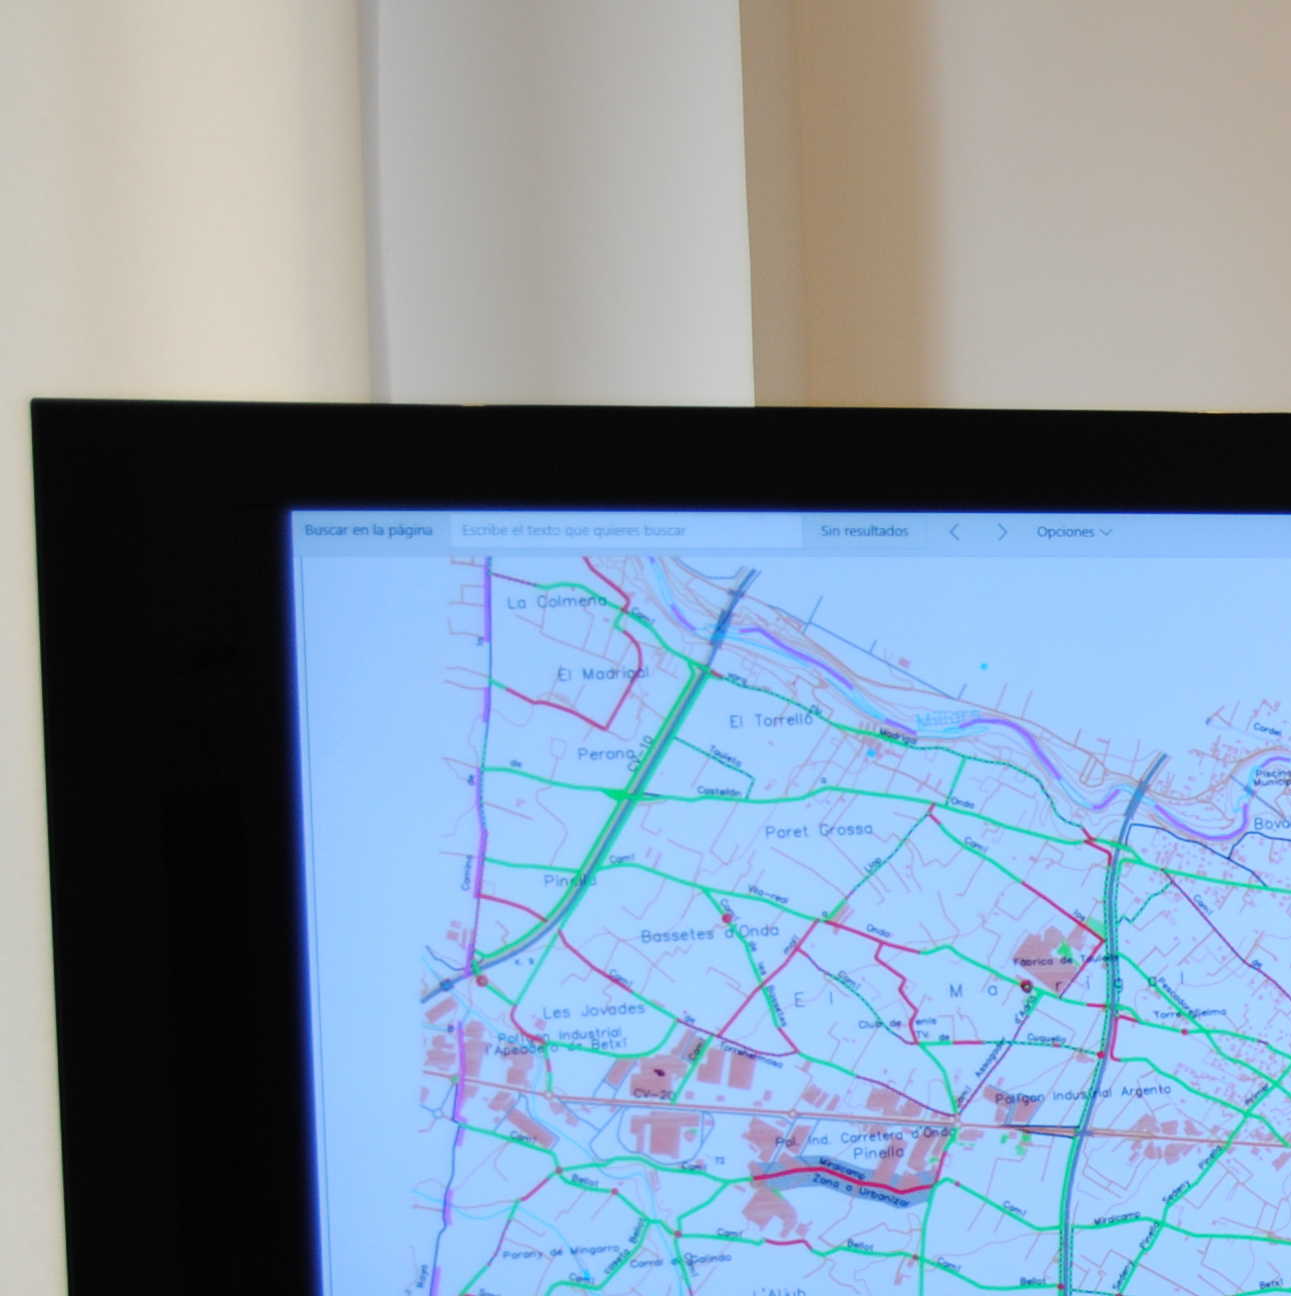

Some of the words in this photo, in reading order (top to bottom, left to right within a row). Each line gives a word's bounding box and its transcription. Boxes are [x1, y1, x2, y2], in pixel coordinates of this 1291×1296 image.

[304, 523, 348, 536] Buscar
[352, 526, 369, 536] en
[372, 523, 385, 536] la
[388, 523, 433, 540] página
[461, 524, 511, 537] Escribe
[512, 524, 524, 537] el
[527, 525, 561, 537] texto
[565, 527, 590, 539] que
[594, 525, 640, 540] quieres
[644, 524, 686, 537] buscar
[821, 525, 841, 538] Sin
[844, 525, 910, 538] resultados
[1036, 525, 1095, 540] Opciones
[507, 596, 526, 610] La
[582, 666, 649, 681] Madrigal
[729, 714, 743, 729] El
[542, 1007, 572, 1020] Les
